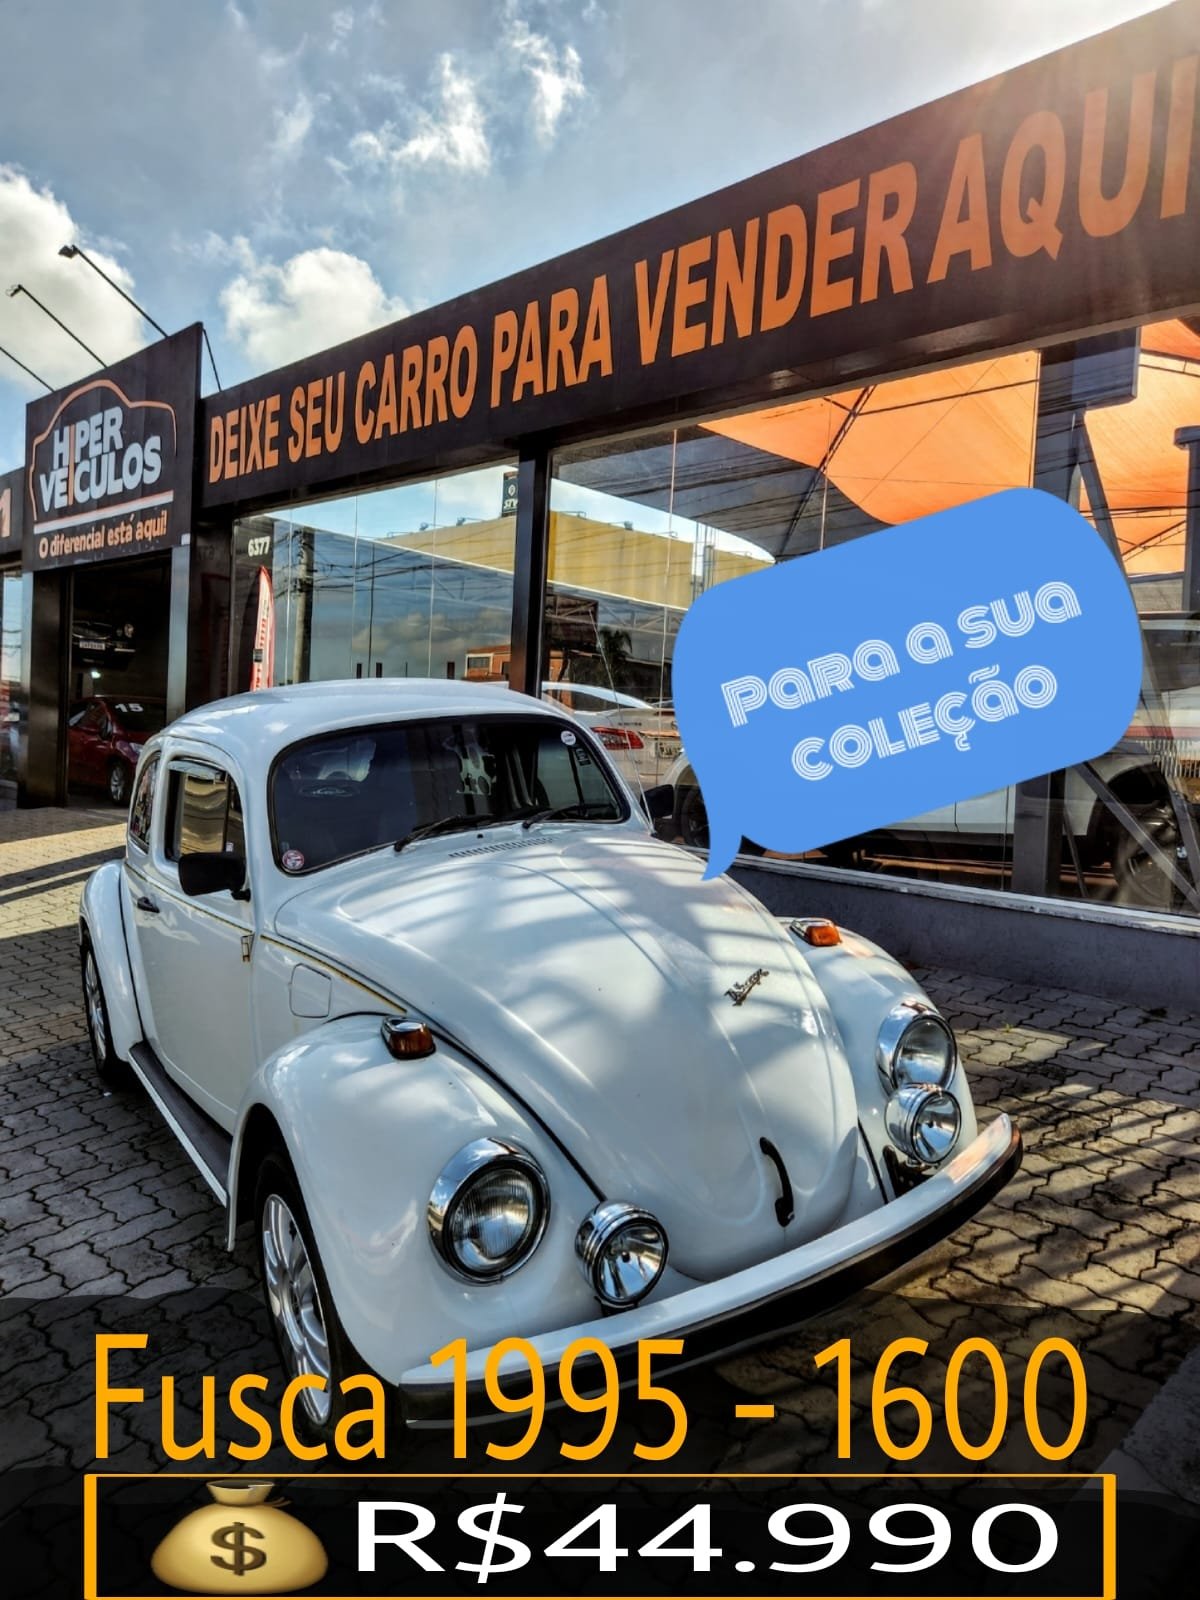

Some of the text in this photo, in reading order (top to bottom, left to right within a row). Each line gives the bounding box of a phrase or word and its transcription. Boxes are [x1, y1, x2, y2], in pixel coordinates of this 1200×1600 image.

[208, 56, 1200, 482] DEIXE SEU CARRO PARA VENDER AQUI
[53, 406, 124, 470] HIPER
[39, 510, 168, 559] O diferencial está aqui!
[248, 536, 271, 557] 6377
[115, 703, 144, 713] 15
